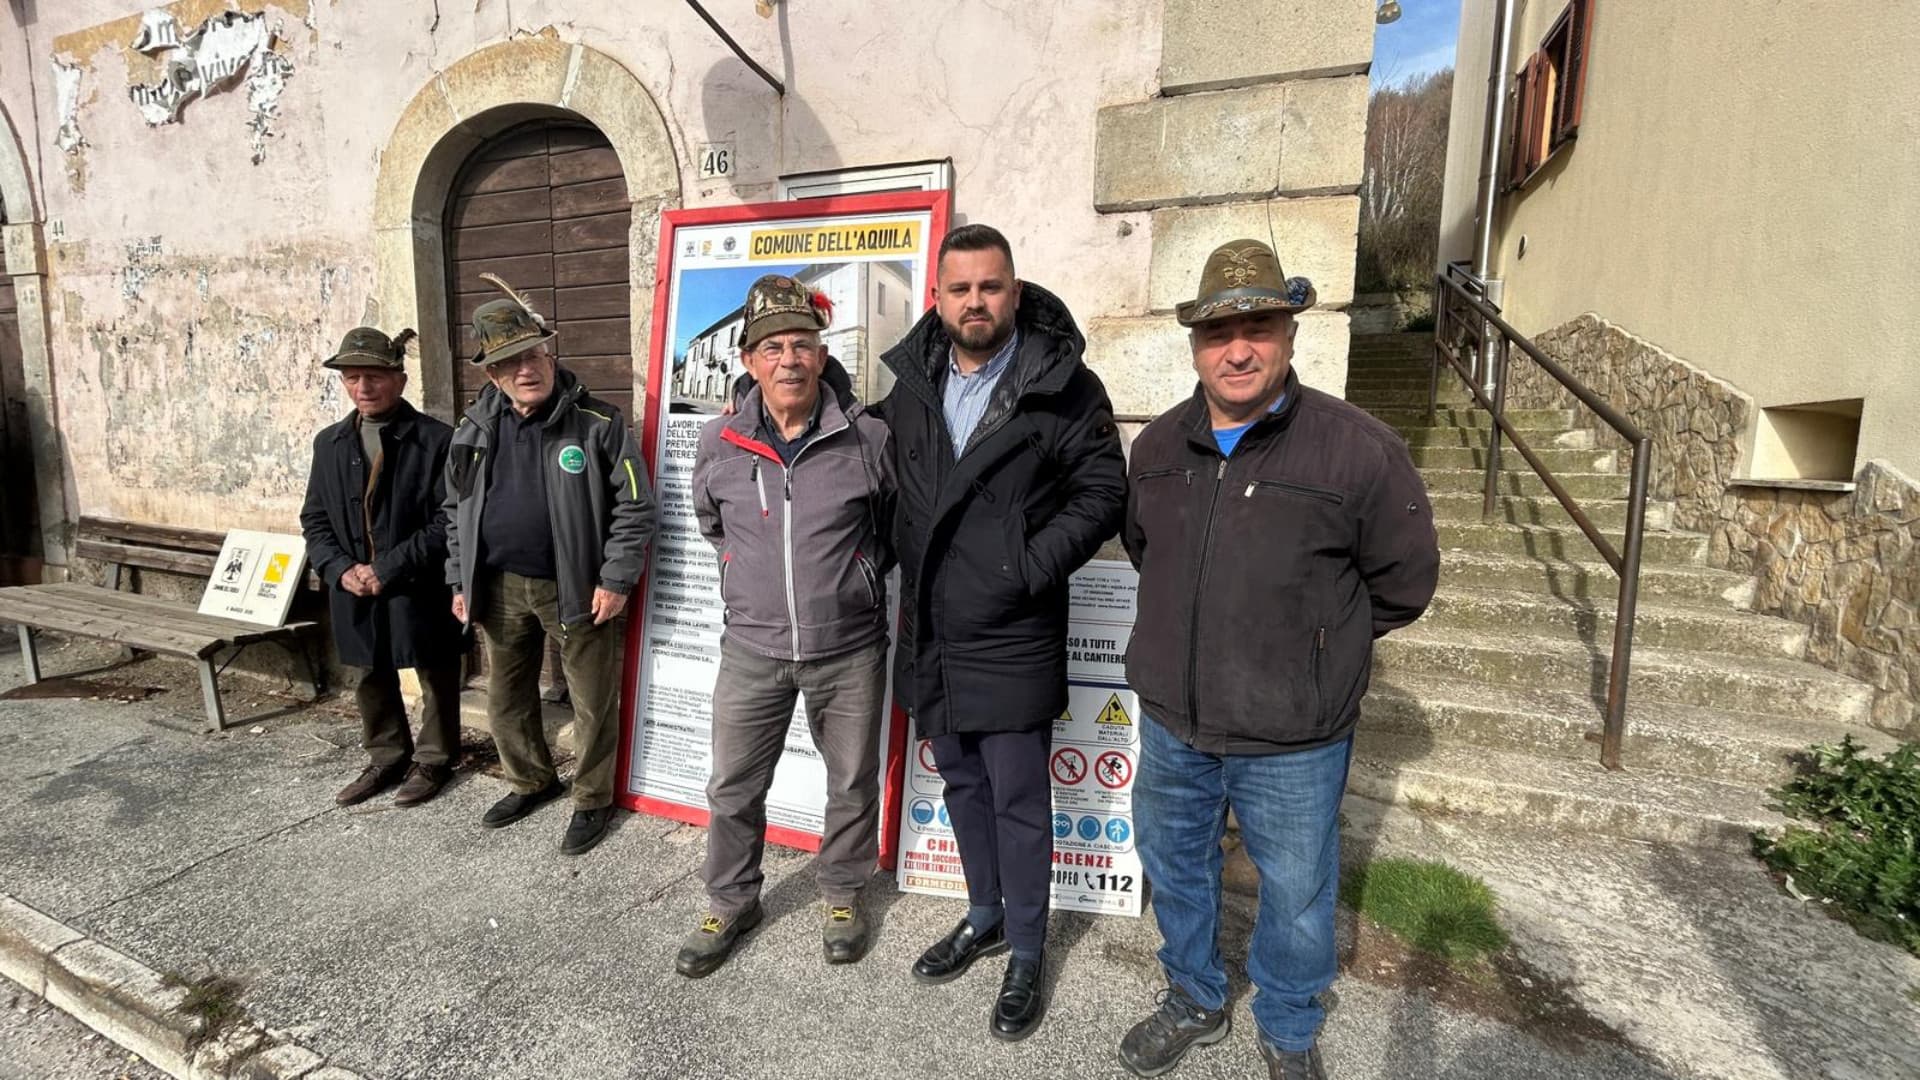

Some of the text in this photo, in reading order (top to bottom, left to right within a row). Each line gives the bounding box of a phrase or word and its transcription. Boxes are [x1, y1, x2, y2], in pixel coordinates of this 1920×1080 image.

[704, 150, 728, 175] 46
[52, 219, 64, 236] 44
[754, 228, 912, 255] COMUNE DELL'AQUILA
[667, 420, 695, 429] LAVORI
[666, 430, 699, 438] DELL'ED
[665, 450, 697, 459] INTERES
[1067, 637, 1116, 650] SO A TUTTE
[1072, 651, 1082, 662] AL
[1084, 652, 1126, 664] CANTIERE
[785, 746, 817, 757] UBAPPALTI
[926, 838, 959, 853] CHI
[906, 851, 961, 865] PRONTO SOCCORS
[1051, 851, 1114, 869] RGENZE
[1096, 872, 1133, 893] 112
